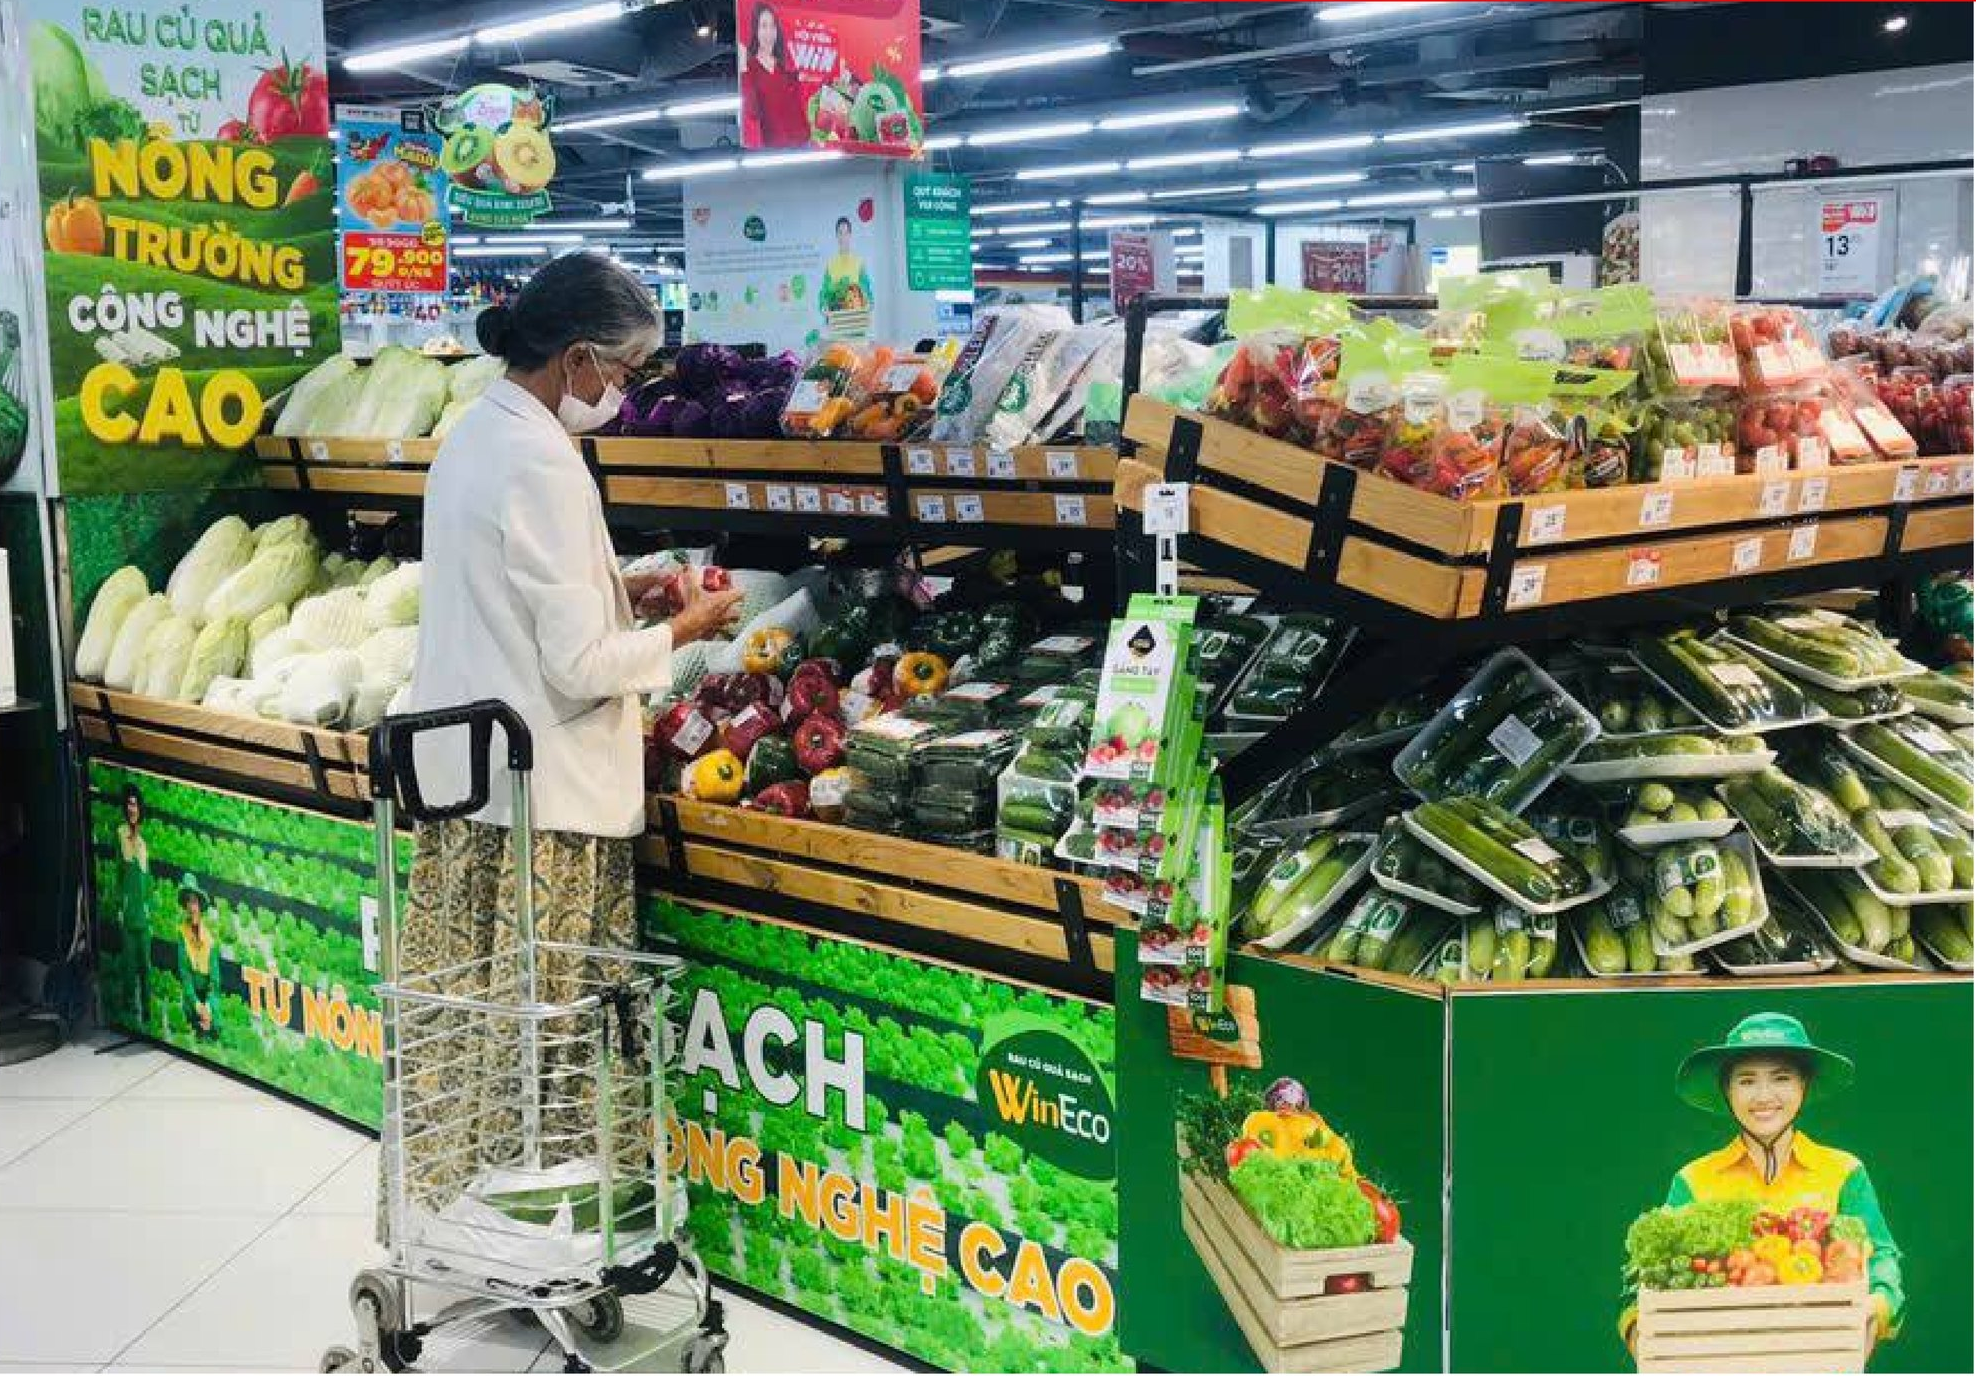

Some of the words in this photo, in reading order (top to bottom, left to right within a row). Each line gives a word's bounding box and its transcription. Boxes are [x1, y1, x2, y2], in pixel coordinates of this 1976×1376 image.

[82, 6, 147, 45] RAU
[155, 4, 197, 51] CỦ
[204, 12, 271, 57] QUẢ
[140, 62, 221, 108] SẠCH
[177, 111, 202, 135] TỪ
[89, 121, 279, 209] NÔNG
[106, 215, 305, 291] TRƯỜNG
[346, 247, 395, 276] 79
[1117, 254, 1149, 271] 20%
[1826, 236, 1849, 258] 13
[68, 284, 183, 332] CÔNG
[194, 299, 312, 357] NGHỆ
[80, 362, 264, 449] CAO
[241, 964, 294, 1026] TỪ
[664, 988, 868, 1131] ẠCH
[990, 1069, 1109, 1143] WinEco
[779, 1152, 948, 1295] NGHỆ
[959, 1222, 1115, 1336] CAO
